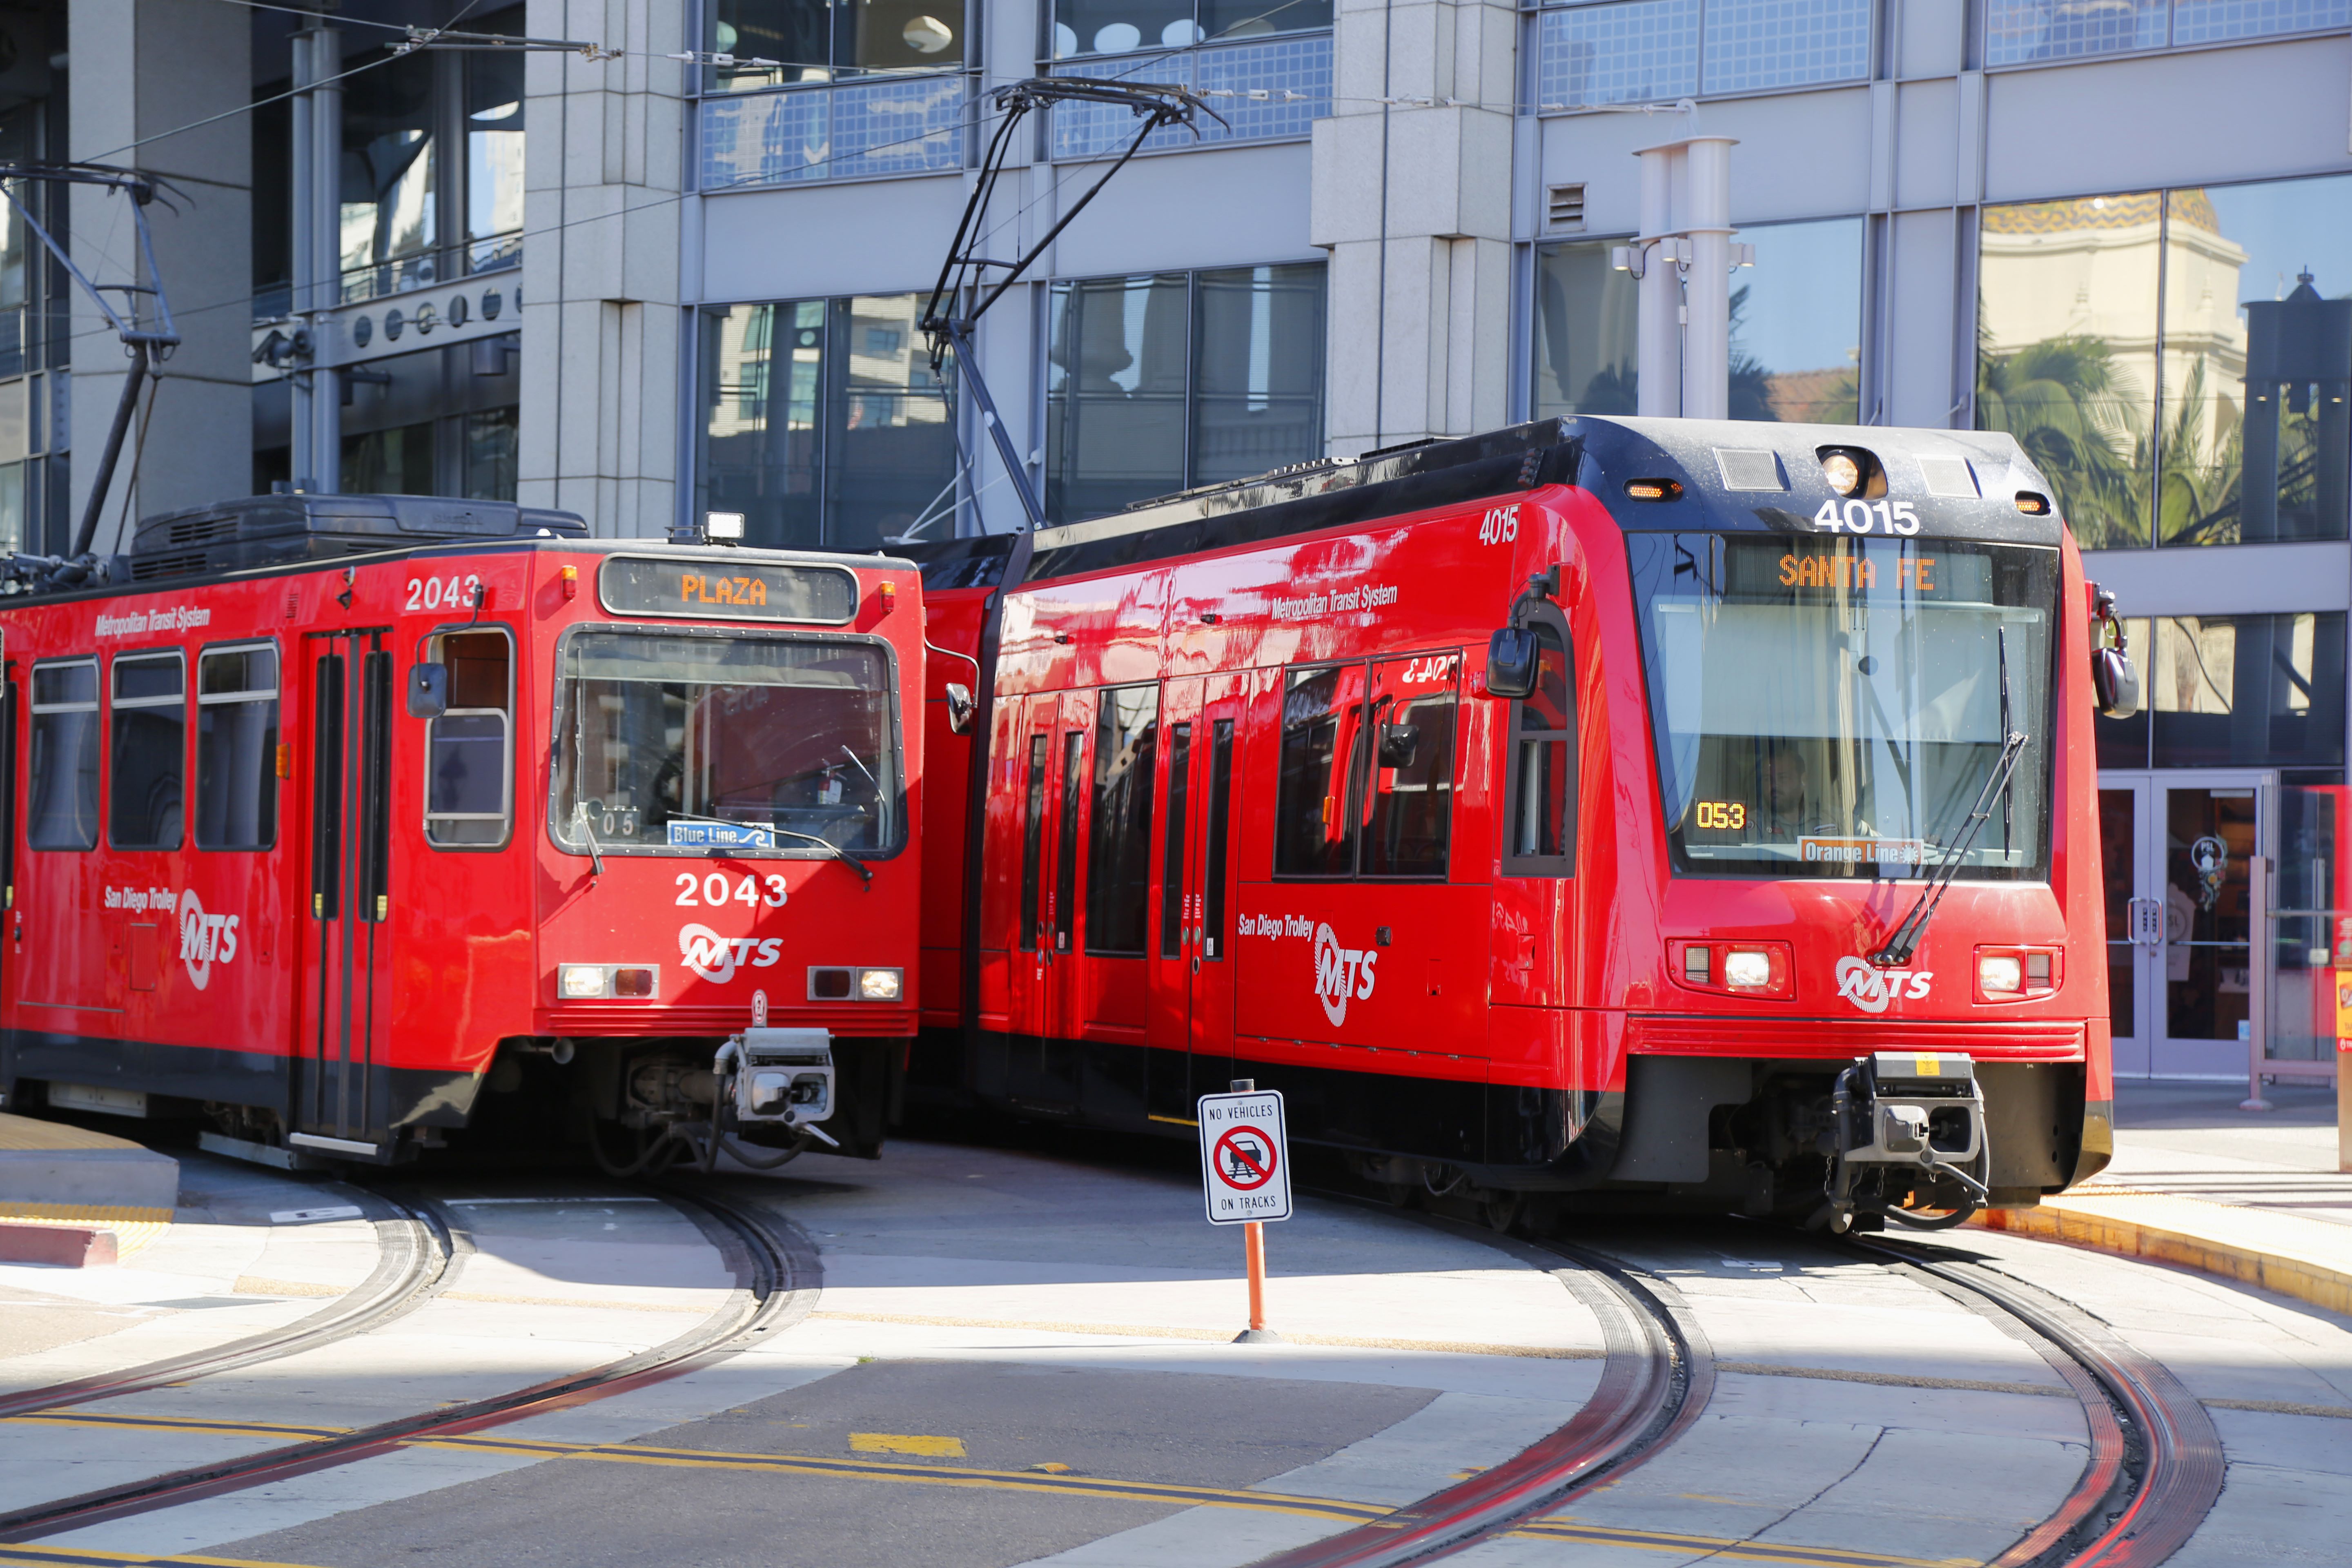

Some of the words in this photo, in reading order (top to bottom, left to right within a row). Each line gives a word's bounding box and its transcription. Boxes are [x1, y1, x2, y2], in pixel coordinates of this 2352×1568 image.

[1479, 506, 1518, 546] 4015
[1815, 499, 1920, 536] 4015
[1779, 554, 1876, 588] SANTA
[1896, 558, 1936, 590] FE
[405, 574, 480, 611] 2043
[682, 575, 766, 606] PLAZA
[1272, 592, 1327, 620] Metropolitan
[1330, 586, 1360, 612] Transit
[1361, 584, 1397, 612] System
[95, 611, 148, 639] Metropolitan
[148, 607, 176, 631] Transit
[176, 605, 210, 633] System
[1697, 802, 1746, 829] 053
[674, 826, 704, 843] Blue
[708, 827, 737, 843] Line
[1805, 841, 1862, 862] Orange
[1866, 843, 1898, 862] Line
[105, 885, 122, 908] San
[122, 886, 148, 914] Diego
[149, 887, 178, 914] Trolley
[675, 873, 788, 907] 2043
[180, 913, 240, 964] MTS
[1238, 913, 1255, 935] San
[1257, 914, 1283, 941] Diego
[1285, 914, 1314, 942] Trolley
[680, 938, 784, 967] MTS
[1314, 948, 1378, 1000] MTS
[1838, 970, 1934, 1000] MTS
[1209, 1109, 1222, 1120] NO
[1228, 1105, 1273, 1119] VEHICLES
[1221, 1198, 1234, 1210] ON
[1241, 1196, 1276, 1209] TRACKS
